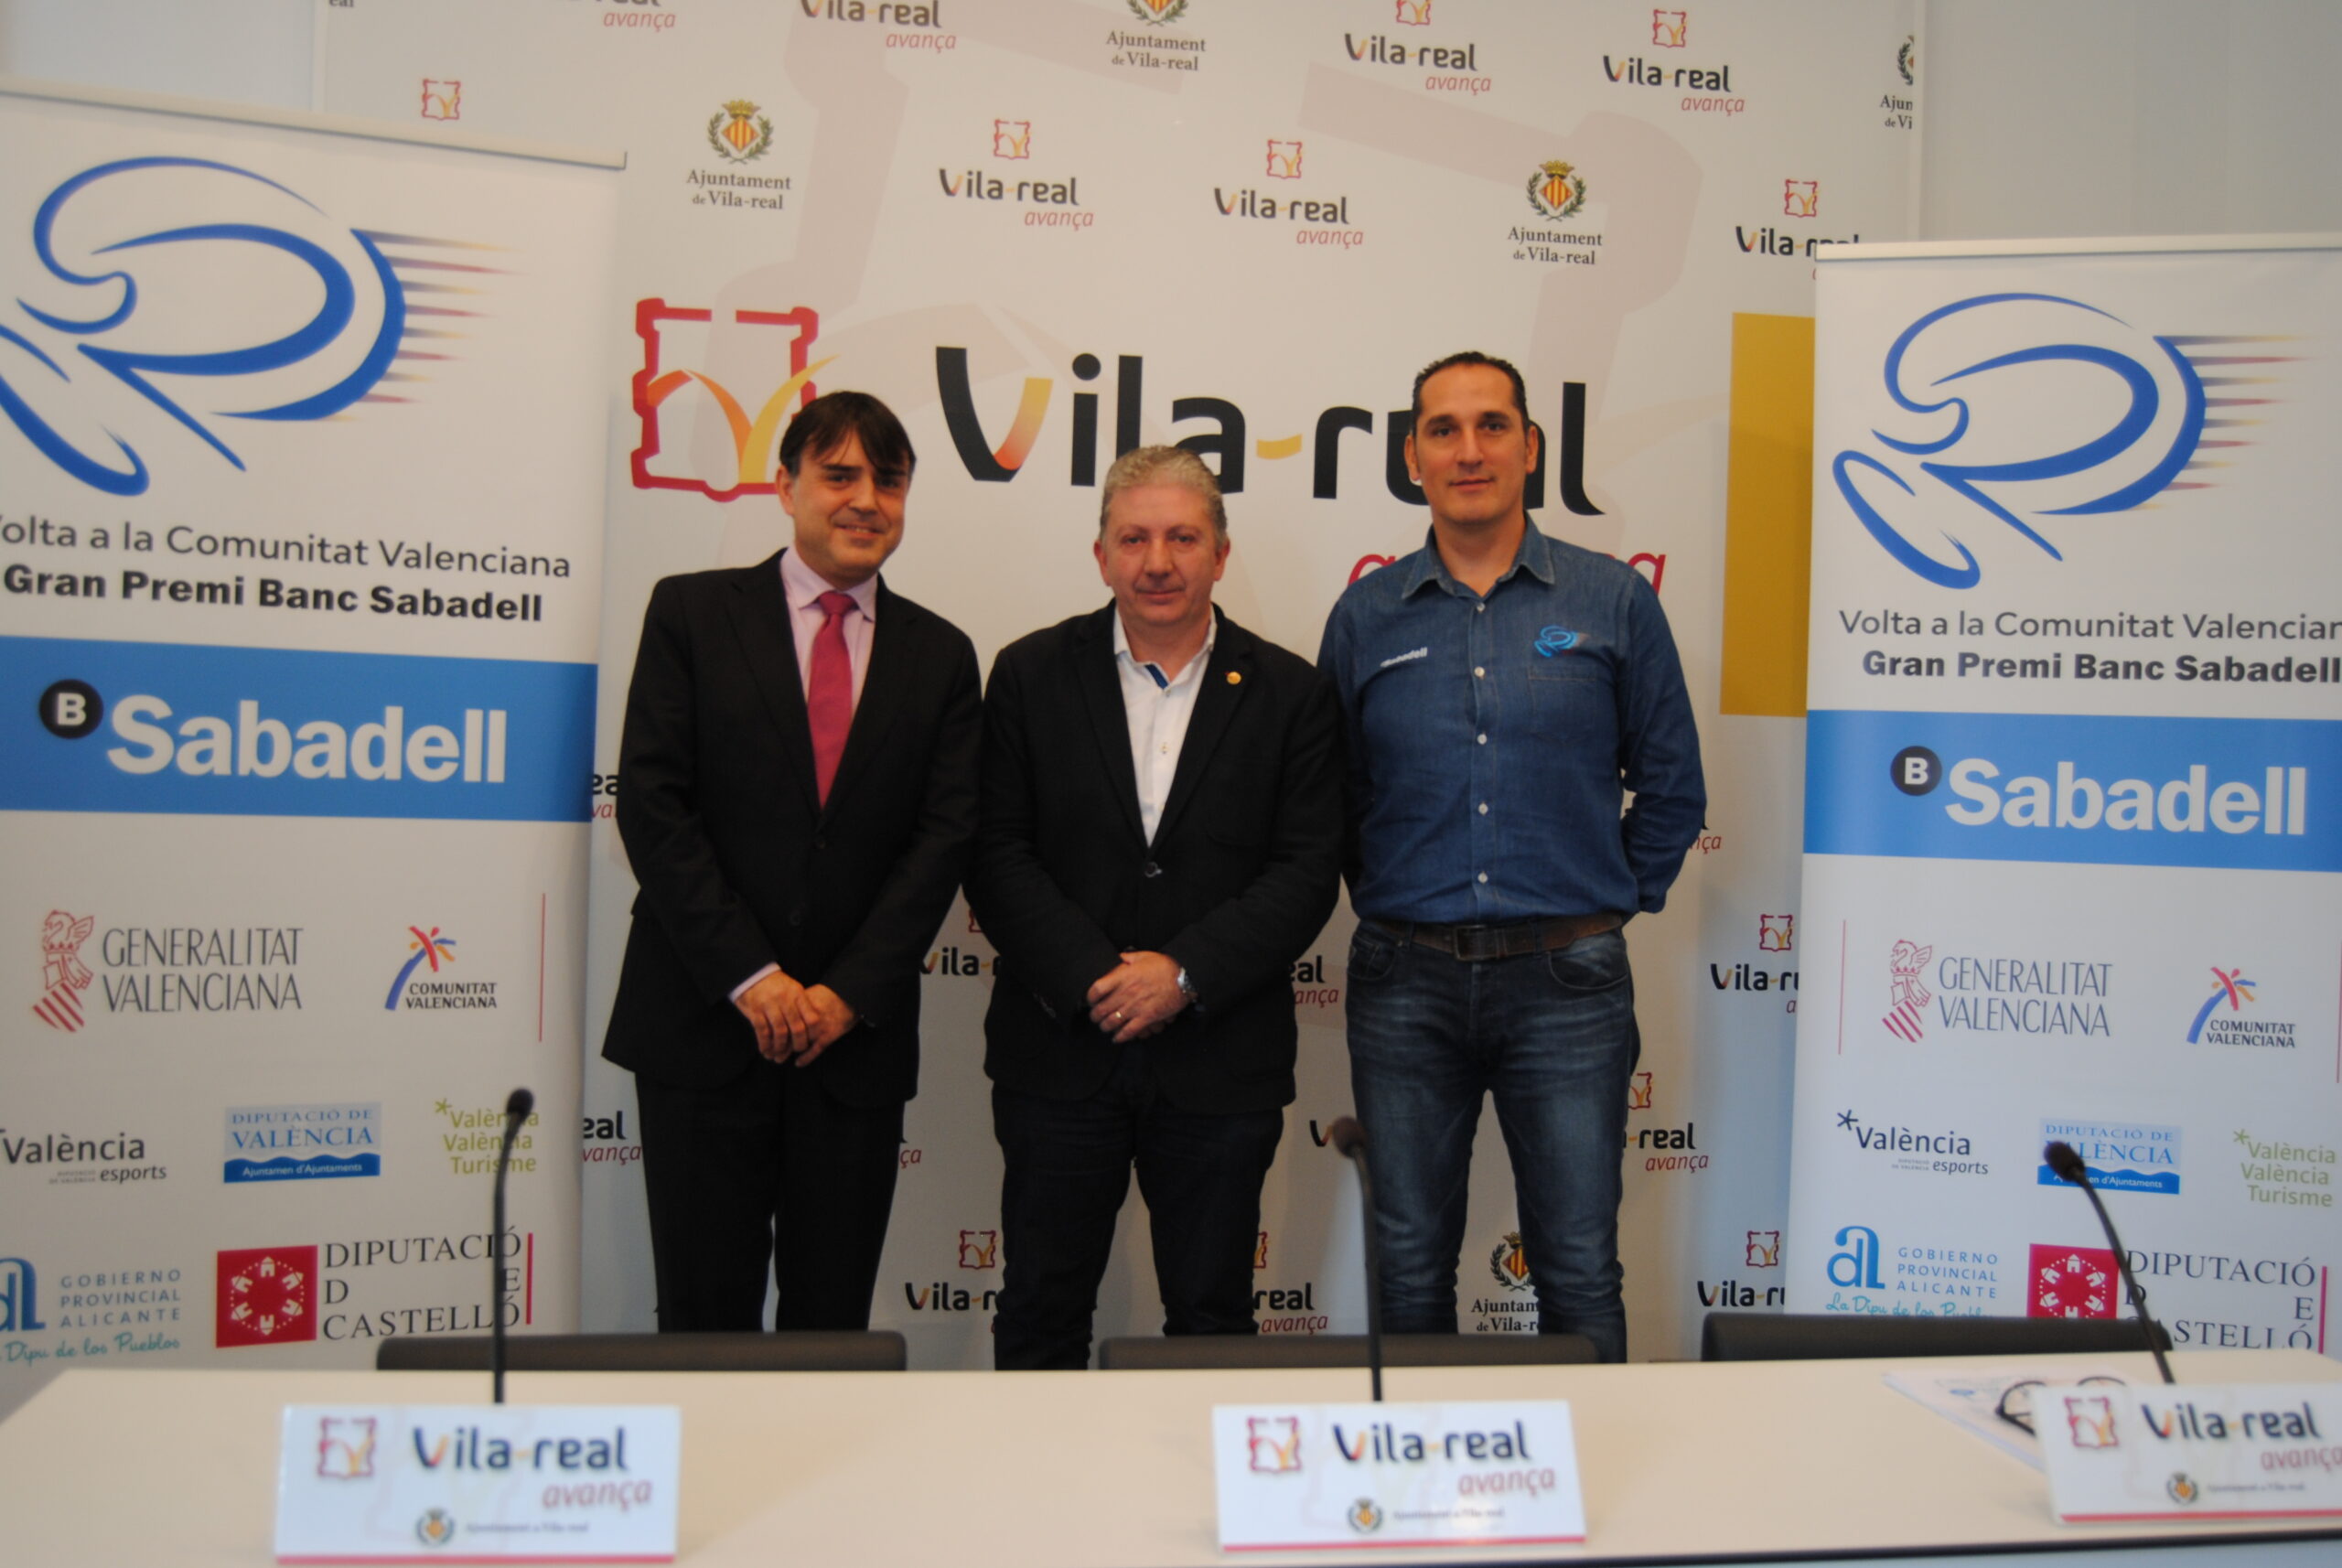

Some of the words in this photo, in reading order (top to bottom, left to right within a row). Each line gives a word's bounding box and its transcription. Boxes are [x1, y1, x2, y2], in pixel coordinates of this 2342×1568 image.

[602, 5, 677, 33] avança
[800, 0, 941, 28] Vila-real
[885, 33, 957, 54] avança
[1106, 30, 1206, 53] Ajuntament
[1344, 33, 1477, 71] Vila-real
[1111, 54, 1125, 66] de
[1126, 50, 1198, 71] Vila-real
[1424, 70, 1492, 94] avança
[1603, 55, 1731, 93] Vila-real
[1681, 92, 1746, 115] avança
[1884, 117, 1896, 128] de
[686, 168, 791, 192] Ajuntament
[939, 167, 1080, 206] Vila-real
[692, 194, 706, 205] de
[707, 188, 783, 210] Vila-real
[1213, 187, 1349, 225] Vila-real
[1024, 206, 1094, 231] avança
[1295, 224, 1364, 250] avança
[1508, 226, 1603, 246] Ajuntament
[1735, 225, 1860, 258] Vila-r
[1512, 249, 1526, 261] de
[1524, 243, 1596, 265] Vila-real
[935, 346, 1606, 517] Vila-rl
[0, 515, 77, 547] olta
[90, 527, 110, 549] a
[124, 521, 154, 552] la
[166, 525, 369, 566] Comunitat
[378, 539, 570, 578] Valenciana
[3, 564, 106, 598] Gran
[122, 570, 244, 606] Premi
[259, 578, 358, 612] Banc
[370, 585, 542, 622] Sabadell
[1839, 608, 1921, 635] Volta
[1931, 617, 1948, 636] a
[1959, 610, 1984, 636] la
[1994, 611, 2175, 639] Comunitat
[1863, 650, 1945, 677] Gran
[1958, 651, 2062, 679] Premi
[2074, 653, 2165, 681] Banc
[2175, 654, 2341, 683] Sabadell
[56, 693, 87, 726] B
[107, 693, 507, 784] Sabadell
[1904, 757, 1928, 785] B
[1944, 757, 2307, 836] Sabadell
[102, 928, 302, 968] GENERALITAT
[409, 980, 496, 995] COMUNITAT
[1710, 962, 1799, 992] Vila-r
[1938, 956, 2113, 999] GENERALITAT
[102, 972, 302, 1013] VALENCIANA
[405, 996, 497, 1011] VALENCIANA
[1295, 989, 1339, 1010] ança
[1939, 993, 2111, 1037] VALENCIANA
[2209, 1018, 2295, 1035] COMUNITAT
[2207, 1031, 2295, 1048] VALENCIANA
[231, 1110, 340, 1126] DIPUTACIÓ
[349, 1109, 373, 1121] DE
[449, 1108, 539, 1128] Valèna
[231, 1122, 373, 1150] VALÈNCIA
[443, 1132, 532, 1151] Valènia
[1624, 1122, 1696, 1150] -real
[1855, 1126, 1971, 1156] València
[2045, 1124, 2143, 1143] DIPUTACIÓ
[2151, 1131, 2174, 1143] DE
[2, 1130, 145, 1165] València
[582, 1144, 642, 1166] vança
[2044, 1140, 2174, 1165] LÈNCIA
[2248, 1141, 2336, 1164] València
[99, 1165, 167, 1185] esports
[242, 1166, 294, 1178] Ajuntamen
[295, 1163, 363, 1176] d'Ajuntaments
[1645, 1155, 1709, 1174] avança
[1932, 1160, 1989, 1176] esports
[2240, 1162, 2329, 1185] València
[2101, 1176, 2164, 1189] d'Ajuntaments
[2247, 1184, 2333, 1208] Turisme
[325, 1225, 521, 1269] DIPUTACIÓ
[1897, 1247, 1998, 1266] GOBIERNO
[59, 1269, 181, 1289] GOBIERNO
[1897, 1263, 1997, 1283] PROVINCIAL
[2125, 1250, 2315, 1287] DIPUTACIÓ
[59, 1289, 180, 1308] PROVINCIAL
[325, 1279, 349, 1305] D
[905, 1282, 997, 1312] Vila-r
[1696, 1280, 1786, 1307] Vila-r
[1896, 1279, 1997, 1299] ALICANTE
[59, 1308, 180, 1328] ALICANTE
[323, 1295, 521, 1341] CASTELLÓ
[1470, 1298, 1539, 1317] Ajuntam
[2294, 1296, 2314, 1321] E
[1261, 1316, 1328, 1335] avança
[1476, 1321, 1489, 1332] de
[1489, 1316, 1539, 1333] Vila-r
[5, 1340, 50, 1367] Dipu
[55, 1338, 79, 1359] de
[113, 1330, 182, 1353] Pueblos
[2141, 1402, 2321, 1440] Vila-real
[413, 1427, 626, 1471] Vila-real
[1333, 1421, 1530, 1463] Vila-real
[542, 1479, 653, 1510] avança
[1457, 1467, 1556, 1497] avança
